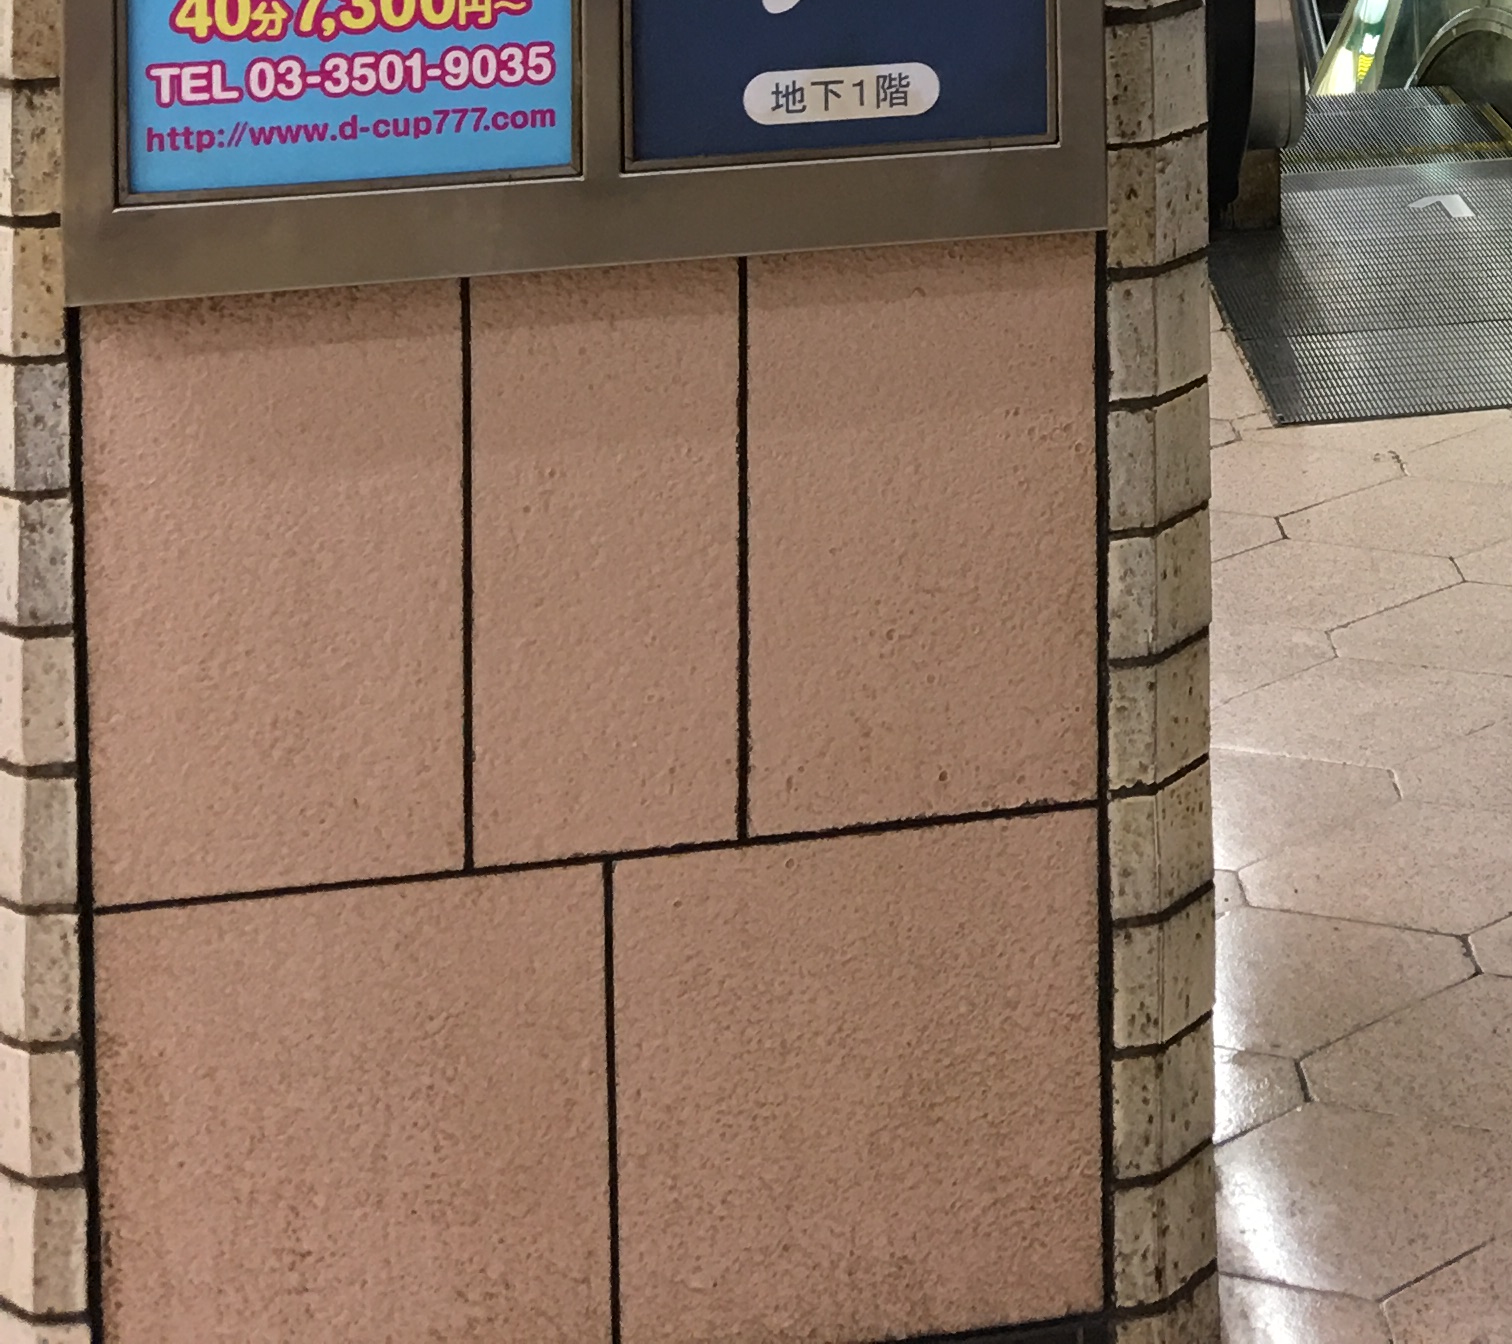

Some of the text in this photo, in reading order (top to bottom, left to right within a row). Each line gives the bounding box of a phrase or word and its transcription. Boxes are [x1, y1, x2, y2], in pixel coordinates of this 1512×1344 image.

[147, 42, 557, 109] TEL 03-3501-9035
[769, 71, 912, 116] 地下1階
[145, 104, 557, 154] http://www.d-cup777.com
